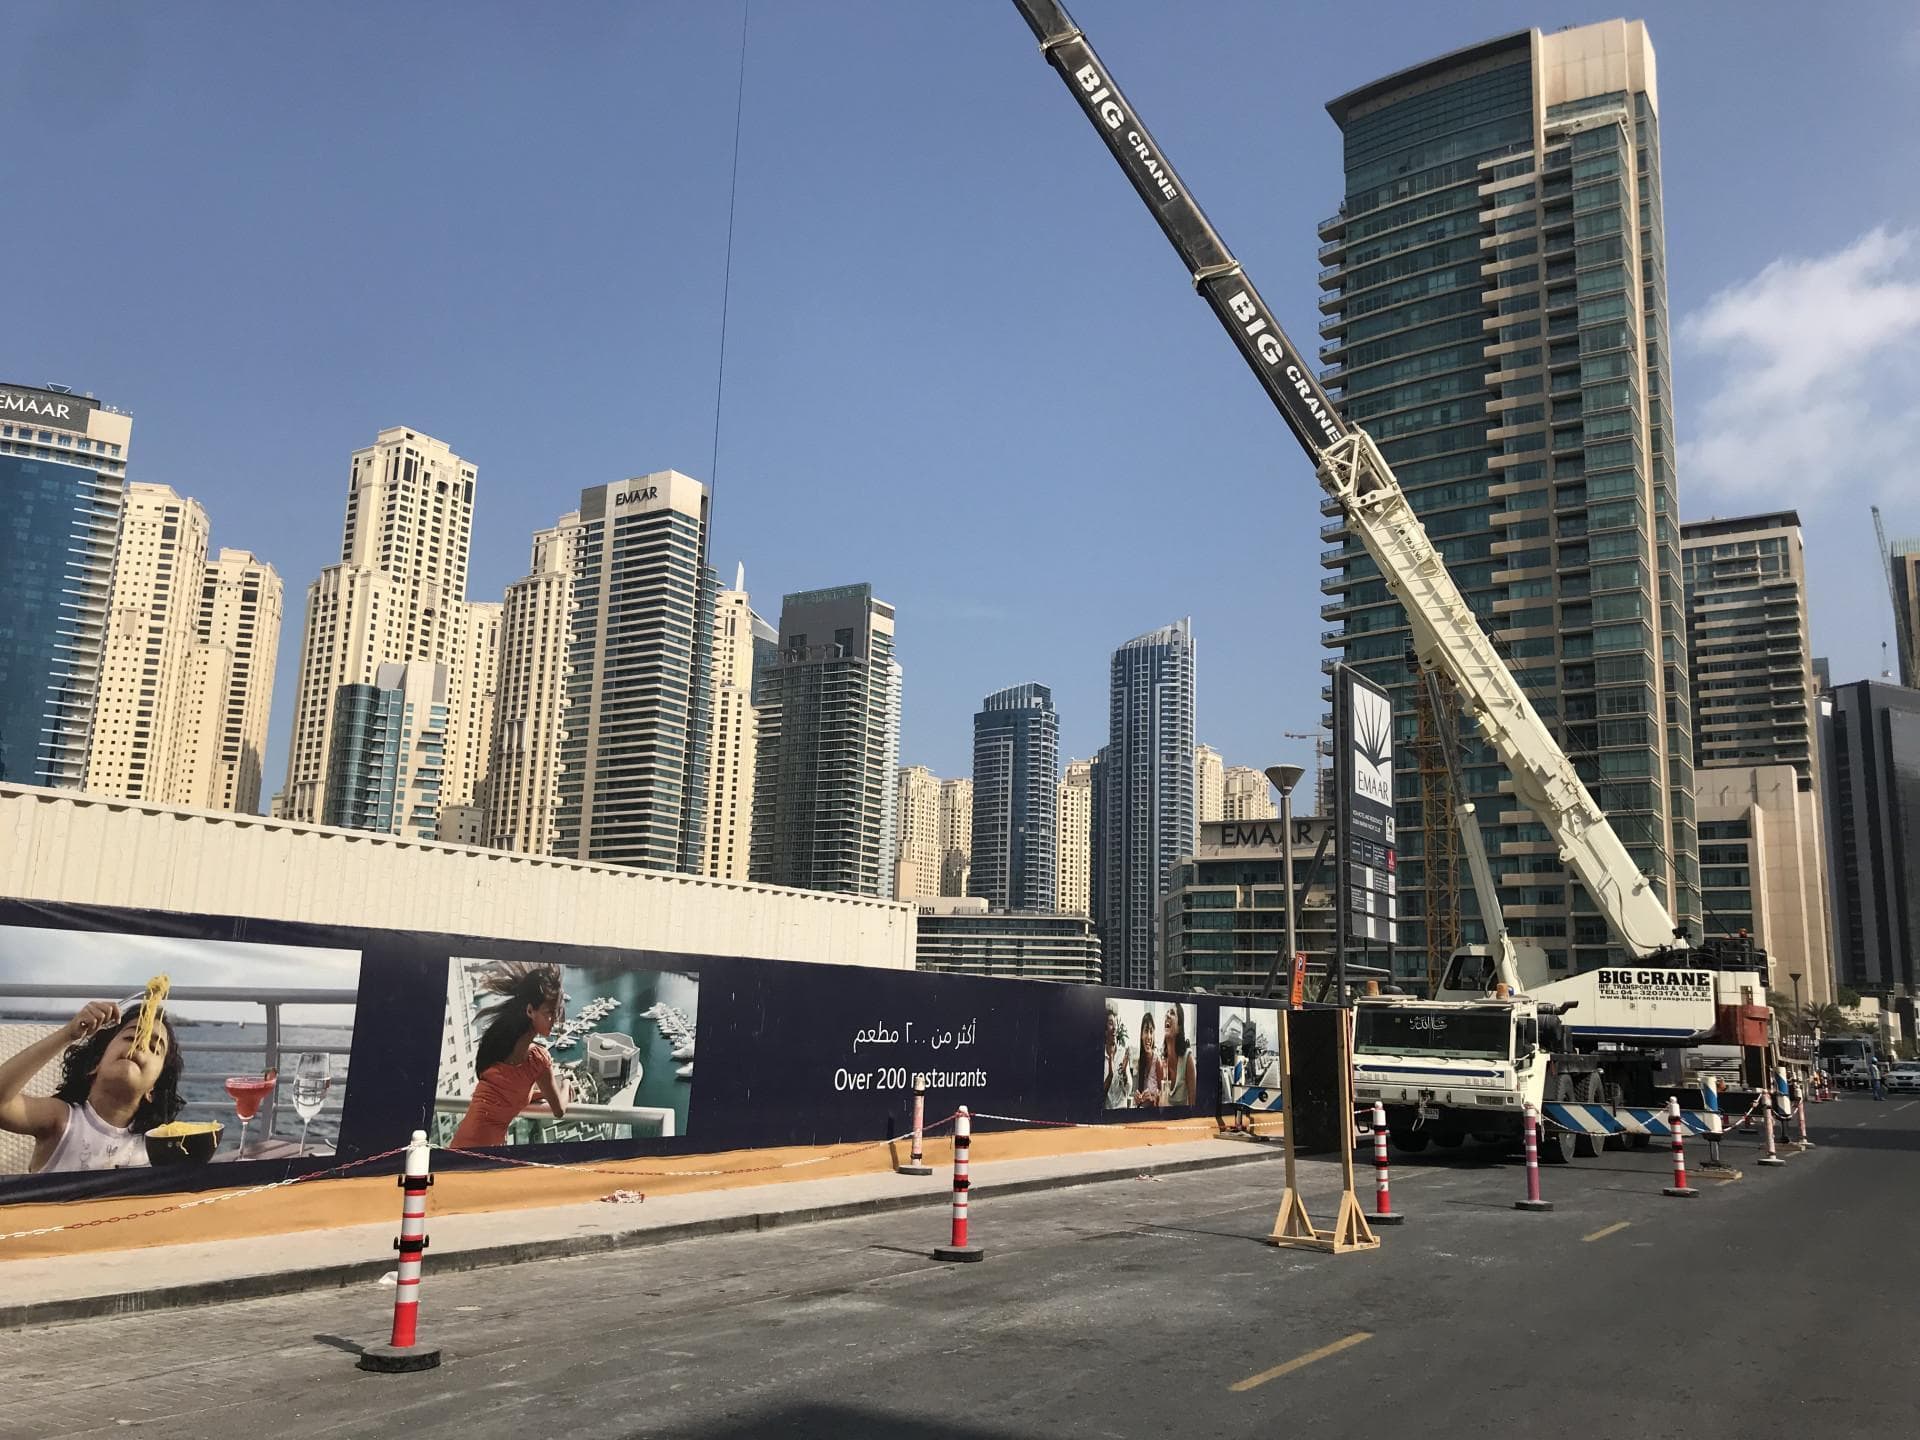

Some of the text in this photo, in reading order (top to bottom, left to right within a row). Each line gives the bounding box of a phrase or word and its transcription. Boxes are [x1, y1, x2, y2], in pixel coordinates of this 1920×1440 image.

[1075, 63, 1177, 201] BIG CRANE
[1228, 290, 1342, 443] BIG CRANE
[616, 486, 658, 506] EMAAR
[1358, 770, 1389, 801] EMAAR
[1598, 970, 1710, 986] BIG CRANE
[853, 1020, 899, 1053] مطعم
[931, 1028, 952, 1050] من
[955, 1018, 976, 1050] أكثر
[834, 1068, 873, 1091] Over
[876, 1067, 907, 1090] 200
